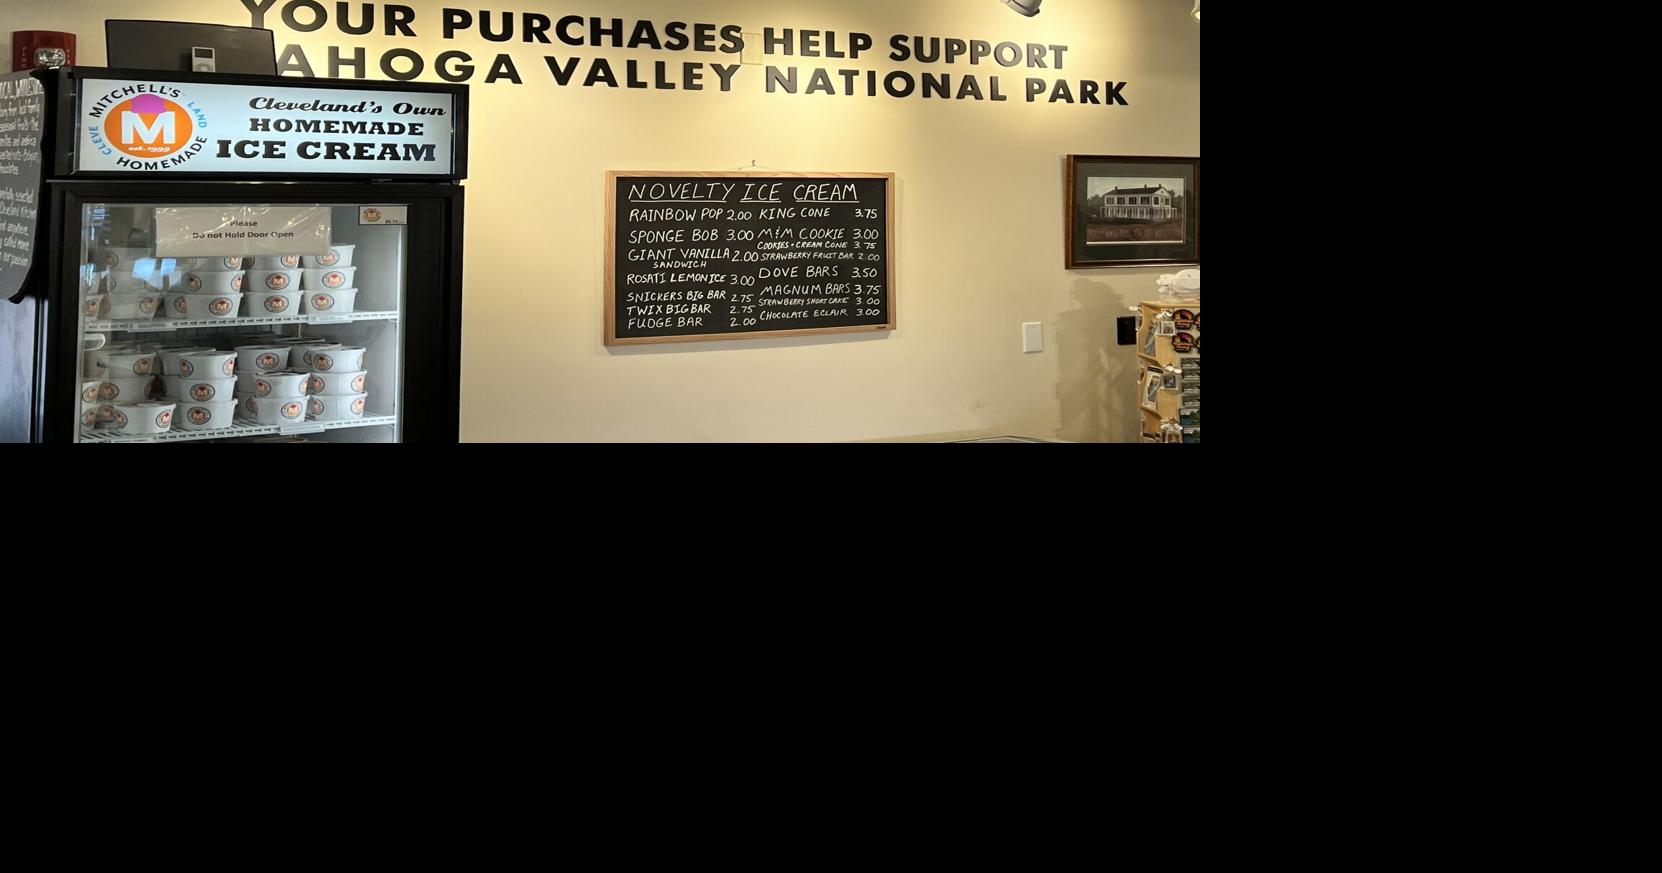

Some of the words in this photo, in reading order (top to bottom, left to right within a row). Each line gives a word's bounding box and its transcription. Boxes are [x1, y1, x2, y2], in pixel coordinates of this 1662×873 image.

[240, 0, 417, 38] YOUR
[442, 7, 744, 54] PURCHASES
[763, 26, 873, 60] HELP
[888, 33, 1068, 70] SUPPORT
[277, 43, 523, 85] AHOGA
[544, 55, 741, 92] VALLEY
[765, 64, 1007, 102] NATIONAL
[1025, 76, 1129, 106] PARK
[88, 83, 181, 118] MITCHELL'S
[249, 97, 383, 113] Cleveland's
[392, 101, 447, 116] Own
[187, 100, 208, 129] LAND
[121, 110, 177, 145] M
[249, 118, 424, 136] HOMEMADE
[88, 125, 112, 156] CLEVE
[116, 136, 208, 171] HOMEMADE
[216, 139, 286, 159] ICE
[296, 140, 436, 162] CREAM
[628, 182, 736, 203] NOVELTY
[739, 182, 783, 203] ICE
[793, 183, 860, 203] CREAM
[629, 208, 697, 222] RAINBOW
[700, 207, 724, 221] POP
[726, 209, 753, 221] 2.00
[759, 207, 797, 220] KING
[800, 207, 831, 218] CONE
[854, 208, 879, 219] 3.75
[247, 231, 269, 239] Door
[270, 231, 294, 240] Open
[628, 229, 684, 244] SPONGE
[691, 229, 719, 241] BOB
[726, 229, 754, 241] 3.00
[799, 227, 846, 240] COOKIE
[852, 228, 879, 240] 3.00
[757, 241, 789, 250] COOKIES
[795, 241, 823, 249] CREAM
[825, 241, 848, 249] CONE
[628, 248, 676, 262] GIANT
[680, 247, 730, 260] VANILLA
[731, 250, 759, 262] 2.00
[760, 252, 811, 262] STRAWBERRY
[813, 251, 837, 260] FRUIT
[838, 251, 854, 260] BAR
[653, 260, 707, 269] SANDWICH
[759, 266, 799, 279] DOVE
[805, 265, 839, 278] BARS
[851, 267, 878, 278] 3.50
[627, 272, 667, 285] ROSATI
[730, 274, 755, 287] 3.00
[627, 291, 683, 302] SNICKERS
[686, 290, 704, 301] BIG
[707, 290, 727, 300] BAR
[760, 284, 822, 296] MAGNUM
[825, 283, 851, 295] BARS
[853, 284, 882, 295] 3.75
[758, 298, 805, 307] STRAWBERRY
[626, 305, 663, 316] TWIX
[730, 305, 756, 314] 2.75
[760, 310, 809, 320] CHOCOLATE
[813, 308, 848, 317] ECLAIR
[856, 308, 880, 316] 3.00
[627, 317, 673, 330] FUDGE
[677, 317, 703, 328] BAR
[730, 317, 757, 327] 2.00
